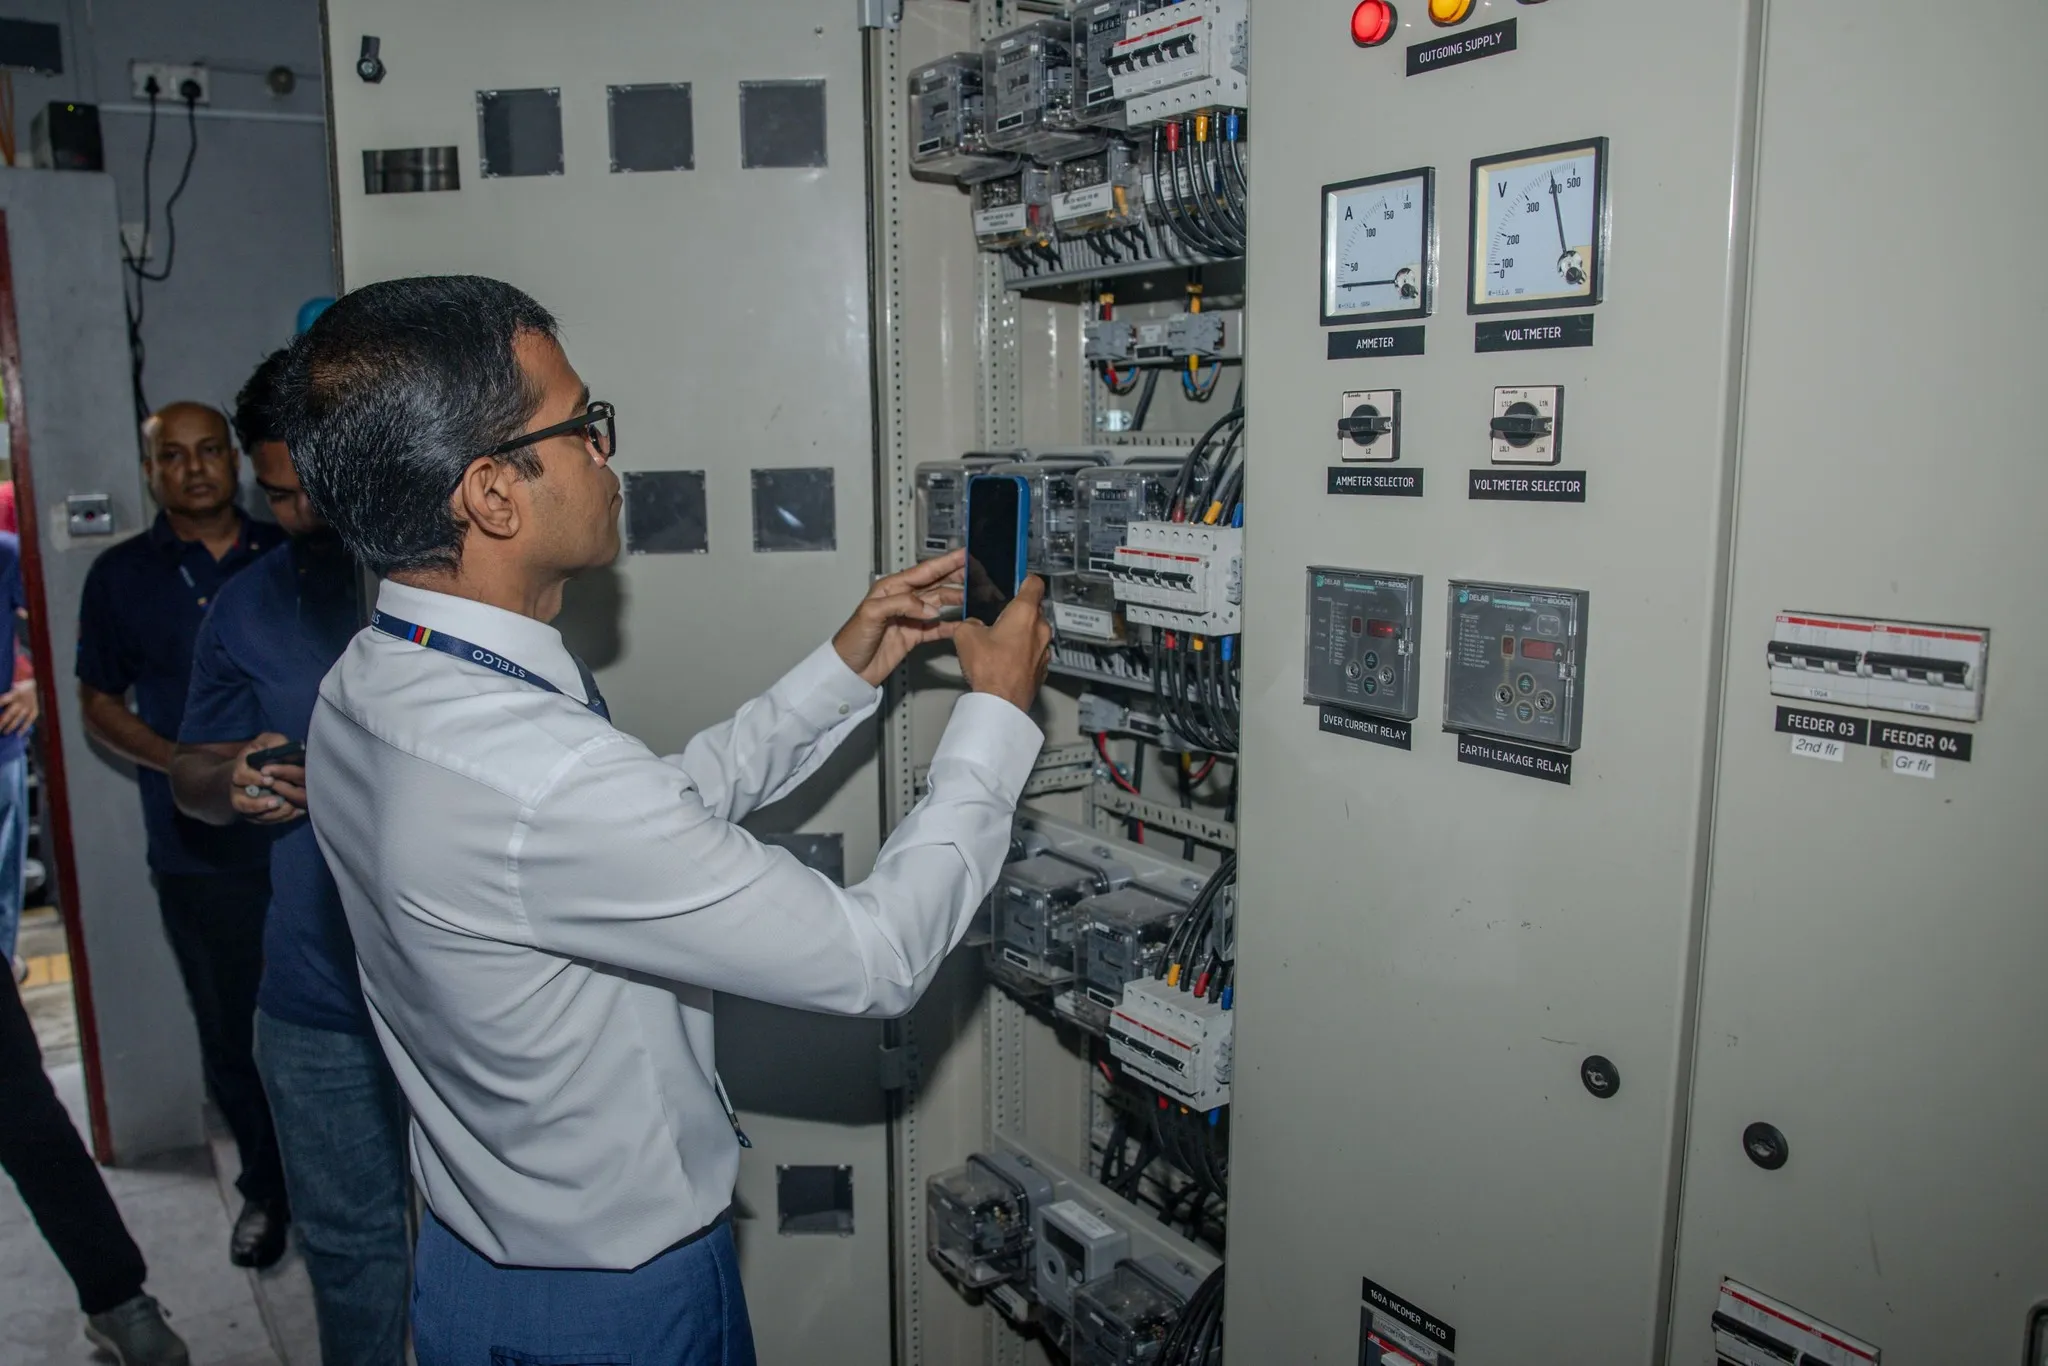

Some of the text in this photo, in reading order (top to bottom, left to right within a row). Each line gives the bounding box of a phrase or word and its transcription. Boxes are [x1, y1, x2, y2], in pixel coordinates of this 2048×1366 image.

[1419, 32, 1503, 63] OUTGOING SUPPLY
[1498, 181, 1507, 197] V
[1567, 176, 1581, 188] 500
[1345, 206, 1353, 221] A
[1526, 202, 1539, 213] 300
[1383, 210, 1394, 220] 150
[1366, 227, 1376, 238] 100
[1506, 234, 1520, 245] 200
[1350, 262, 1358, 272] 50
[1501, 258, 1513, 269] 100
[1500, 268, 1504, 279] 0
[1504, 326, 1561, 341] VOLTMETER
[1356, 337, 1394, 349] AMMETER
[1336, 476, 1414, 488] AMMETER SELECTOR
[1474, 479, 1581, 493] VOLTMETER SELECTOR
[1469, 593, 1489, 602] DELAB
[472, 650, 526, 678] STELCO
[1323, 713, 1407, 741] OVER CURRENT RELAY
[1787, 714, 1856, 737] FEEDER 03
[1795, 738, 1840, 756] 2nd flr
[1882, 727, 1958, 753] FEEDER 04
[1460, 743, 1569, 775] EARTH LEAKAGE RELAY
[1895, 755, 1933, 772] Gr flr
[1370, 1289, 1447, 1340] 160A INCOMER MCCB
